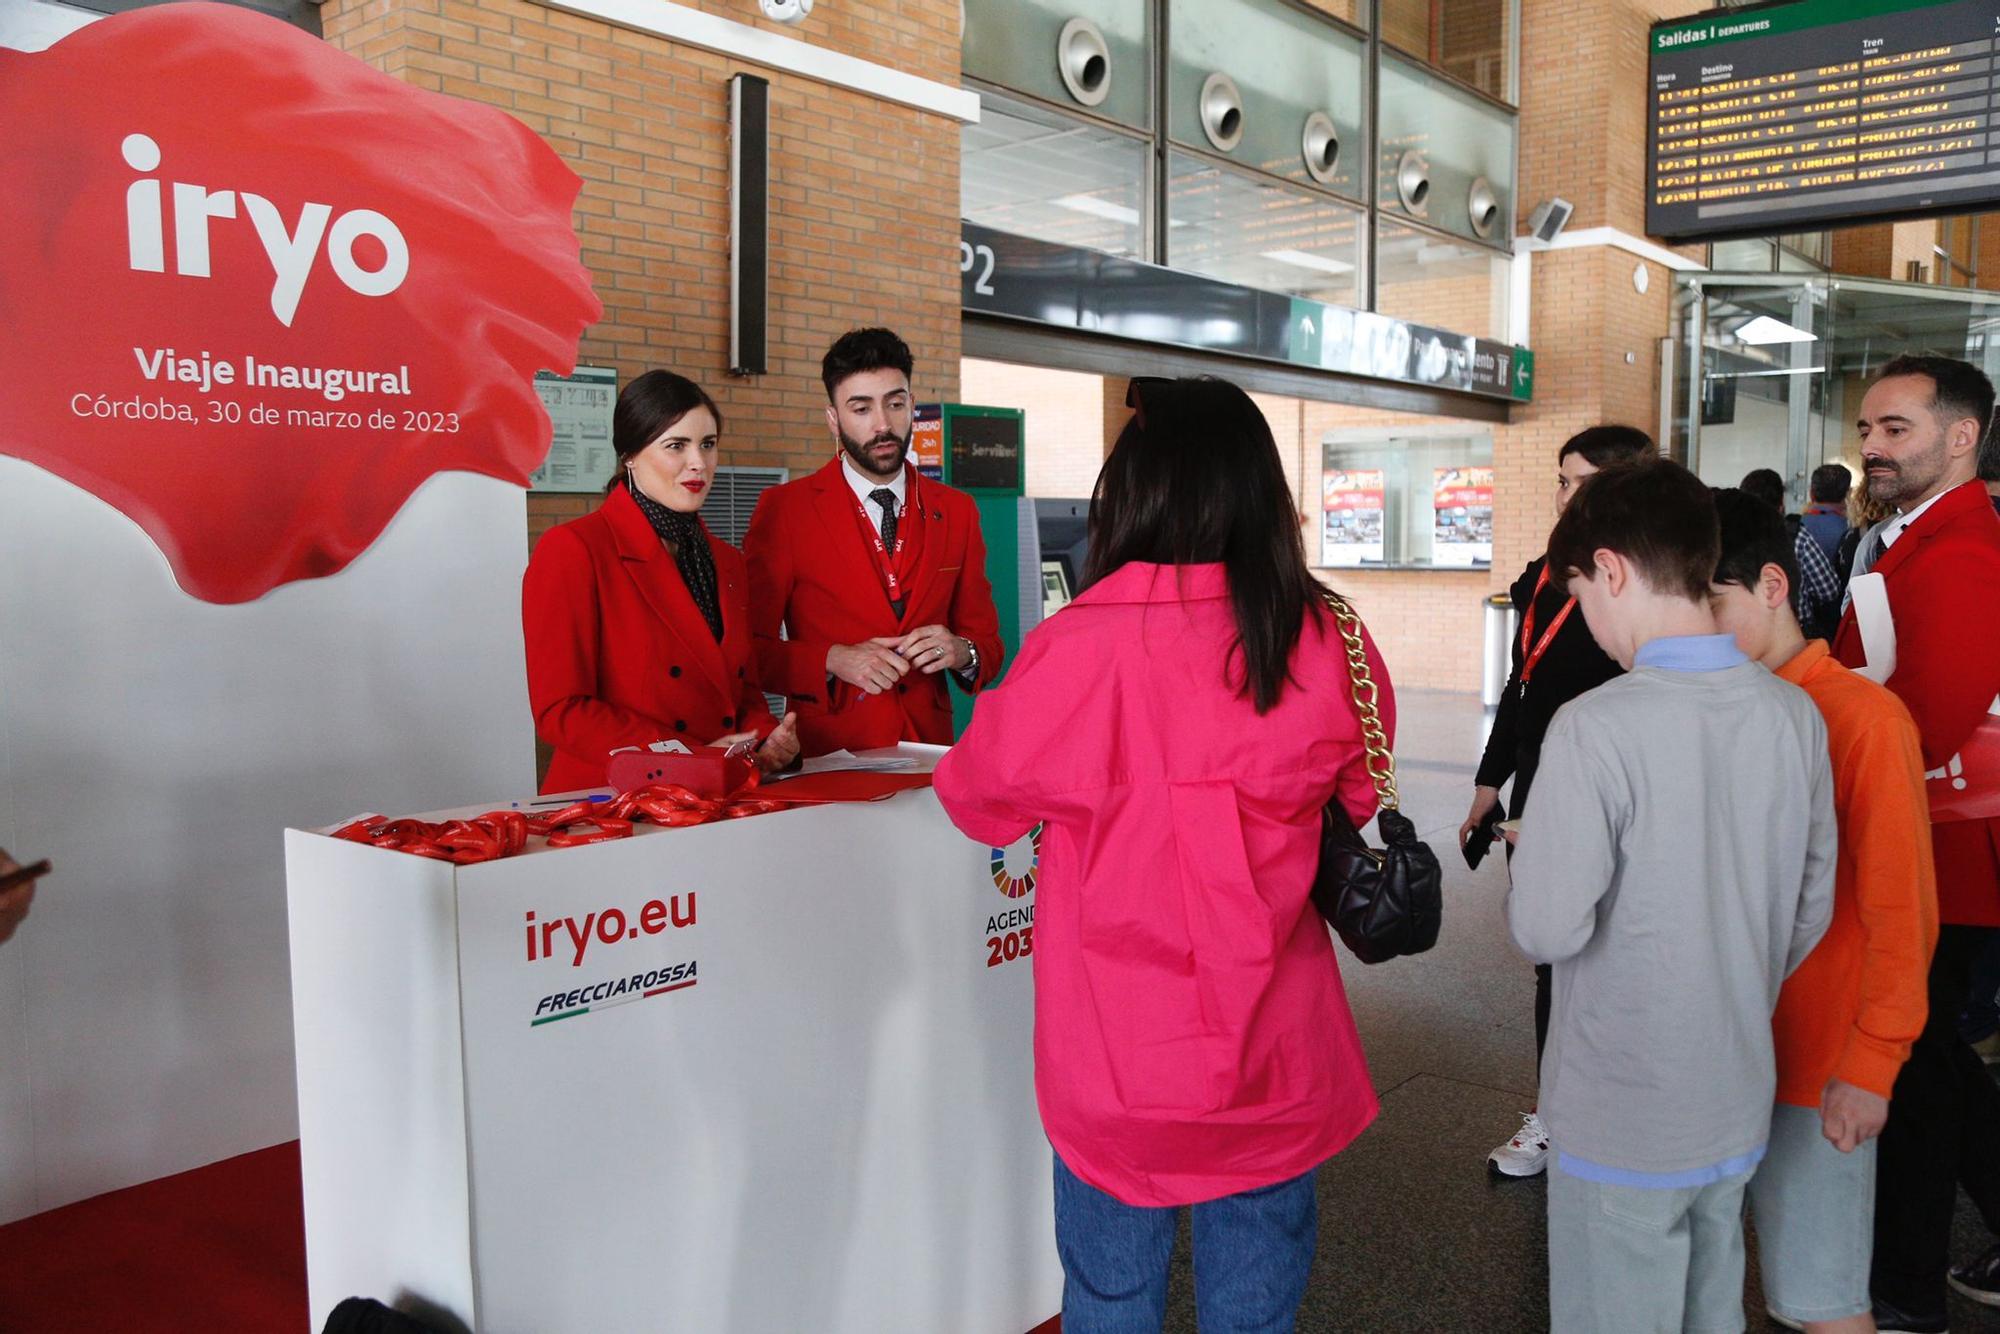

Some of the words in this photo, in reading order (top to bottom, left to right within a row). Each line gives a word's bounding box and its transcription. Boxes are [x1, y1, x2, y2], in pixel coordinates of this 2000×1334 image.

[1658, 29, 1707, 48] Salidas
[1718, 20, 1770, 37] DEPARTURES
[1862, 38, 1883, 48] Tren
[1701, 64, 1733, 75] Destino
[121, 133, 409, 328] iryo
[134, 347, 234, 393] Viaje
[245, 356, 411, 401] Inaugural
[71, 393, 199, 425] Córdoba,
[208, 400, 241, 424] 30
[249, 402, 280, 425] de
[288, 408, 362, 430] marzo
[367, 408, 396, 430] de
[403, 410, 460, 433] 2023
[526, 892, 696, 966] iryo.eu
[535, 960, 697, 1016] FRECCIAROSSA
